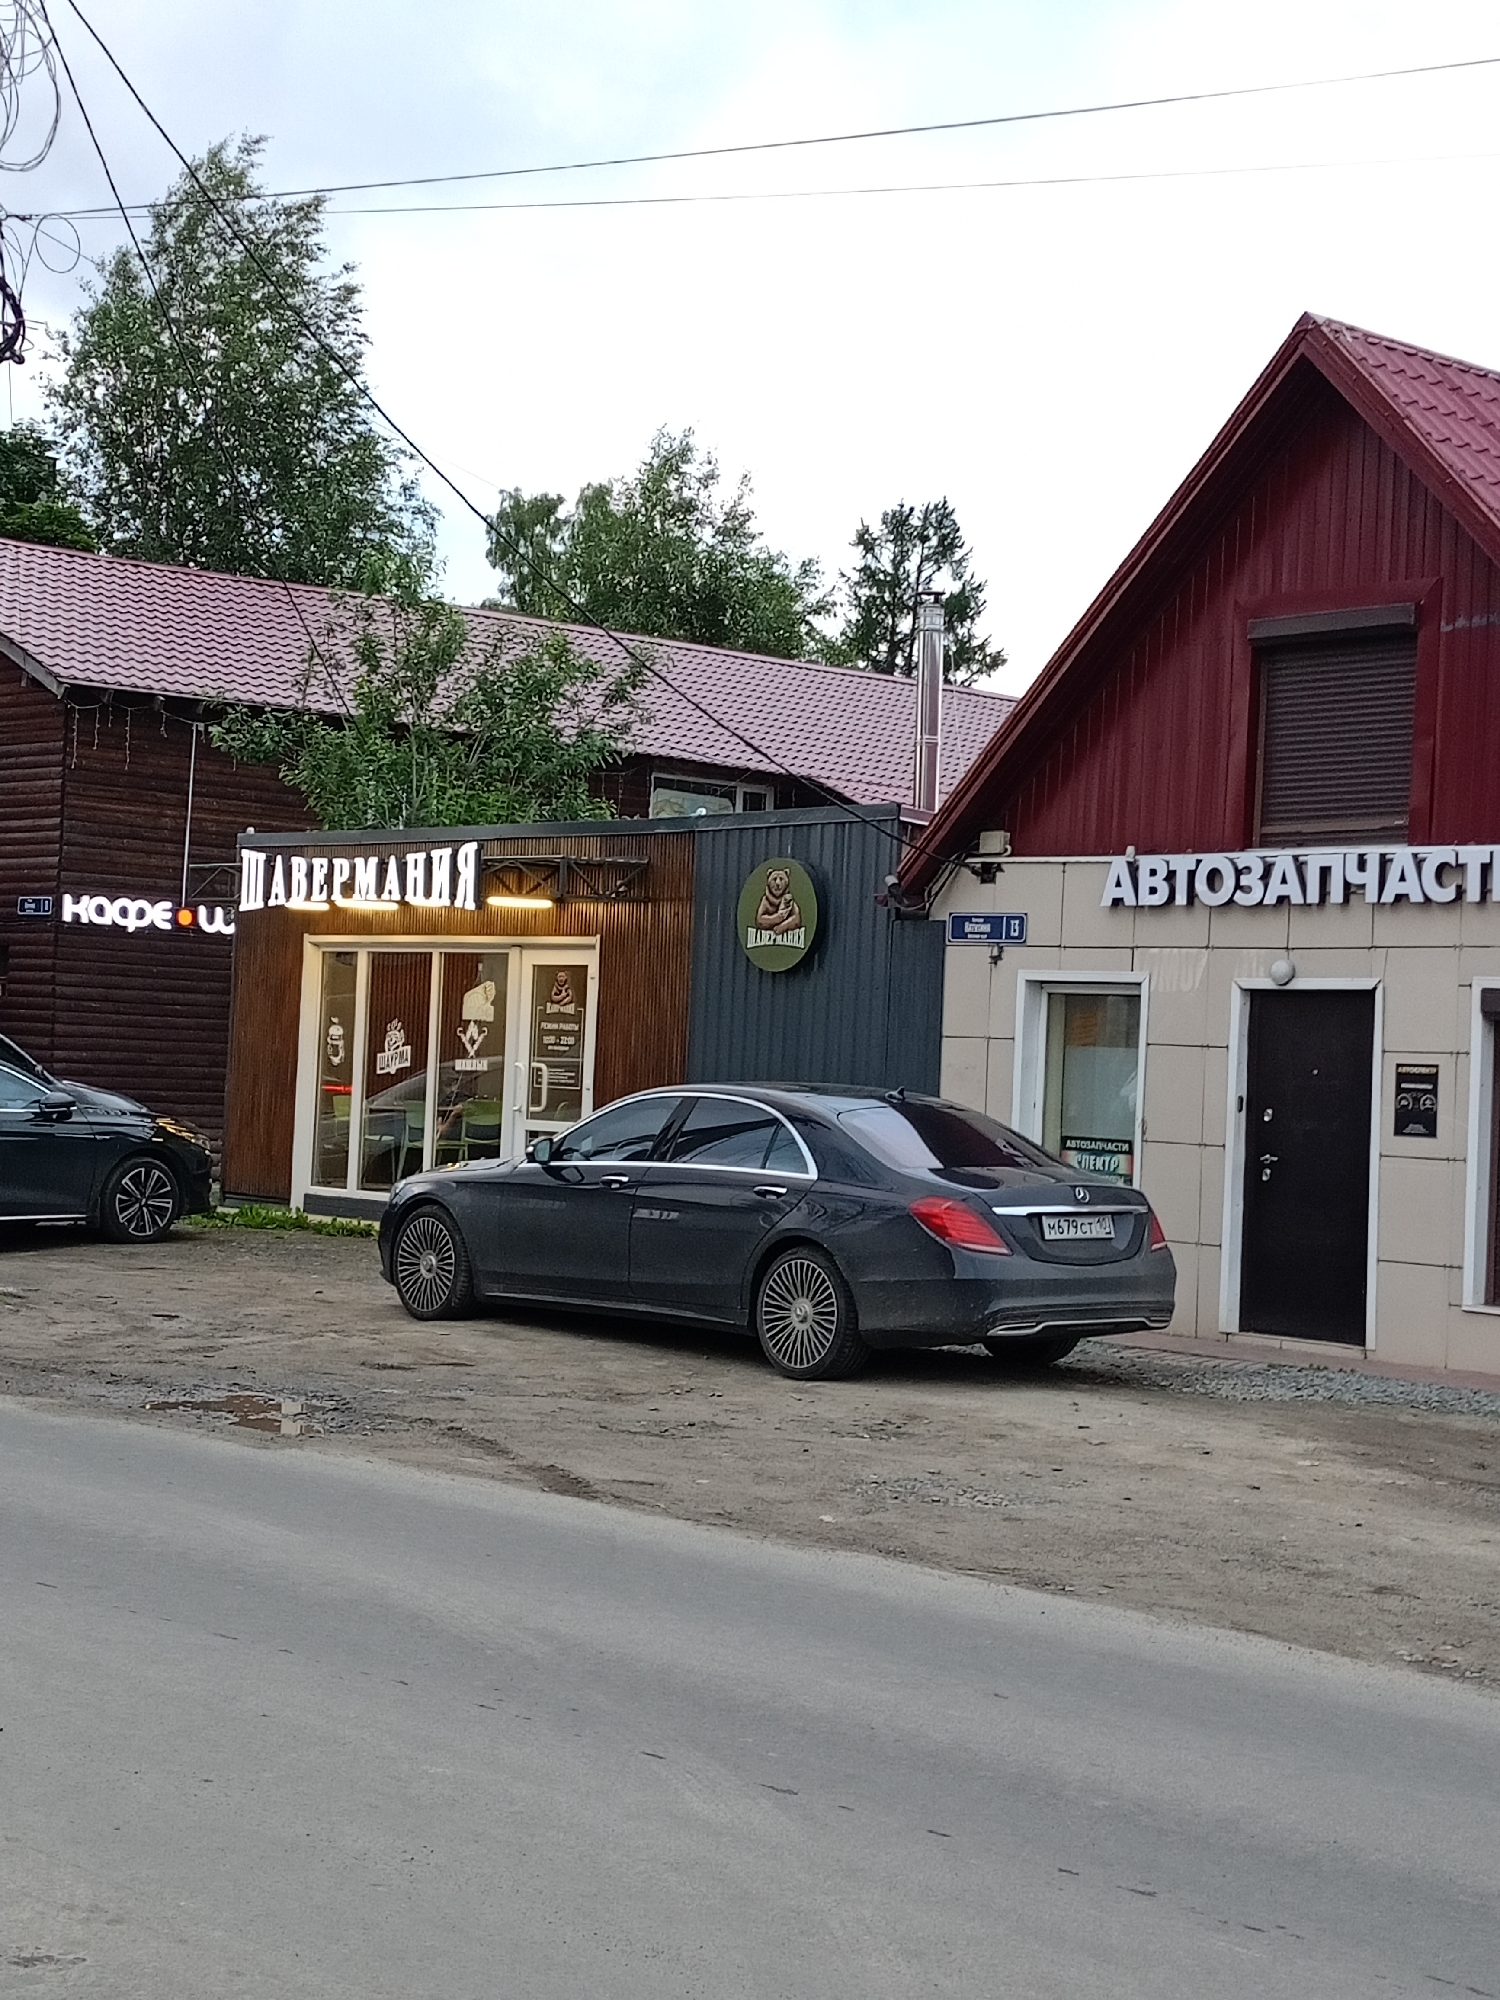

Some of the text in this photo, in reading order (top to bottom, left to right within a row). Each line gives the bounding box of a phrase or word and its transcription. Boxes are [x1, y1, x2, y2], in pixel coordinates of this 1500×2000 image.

[239, 841, 479, 912] ШАВЕРМАНИЯ
[747, 926, 806, 949] ШАВЕРМАНИЯ
[378, 1047, 410, 1070] ШАУРМА
[1065, 1139, 1130, 1152] АВТОЗАПЧАСТИ
[1047, 1218, 1094, 1236] М679СТ
